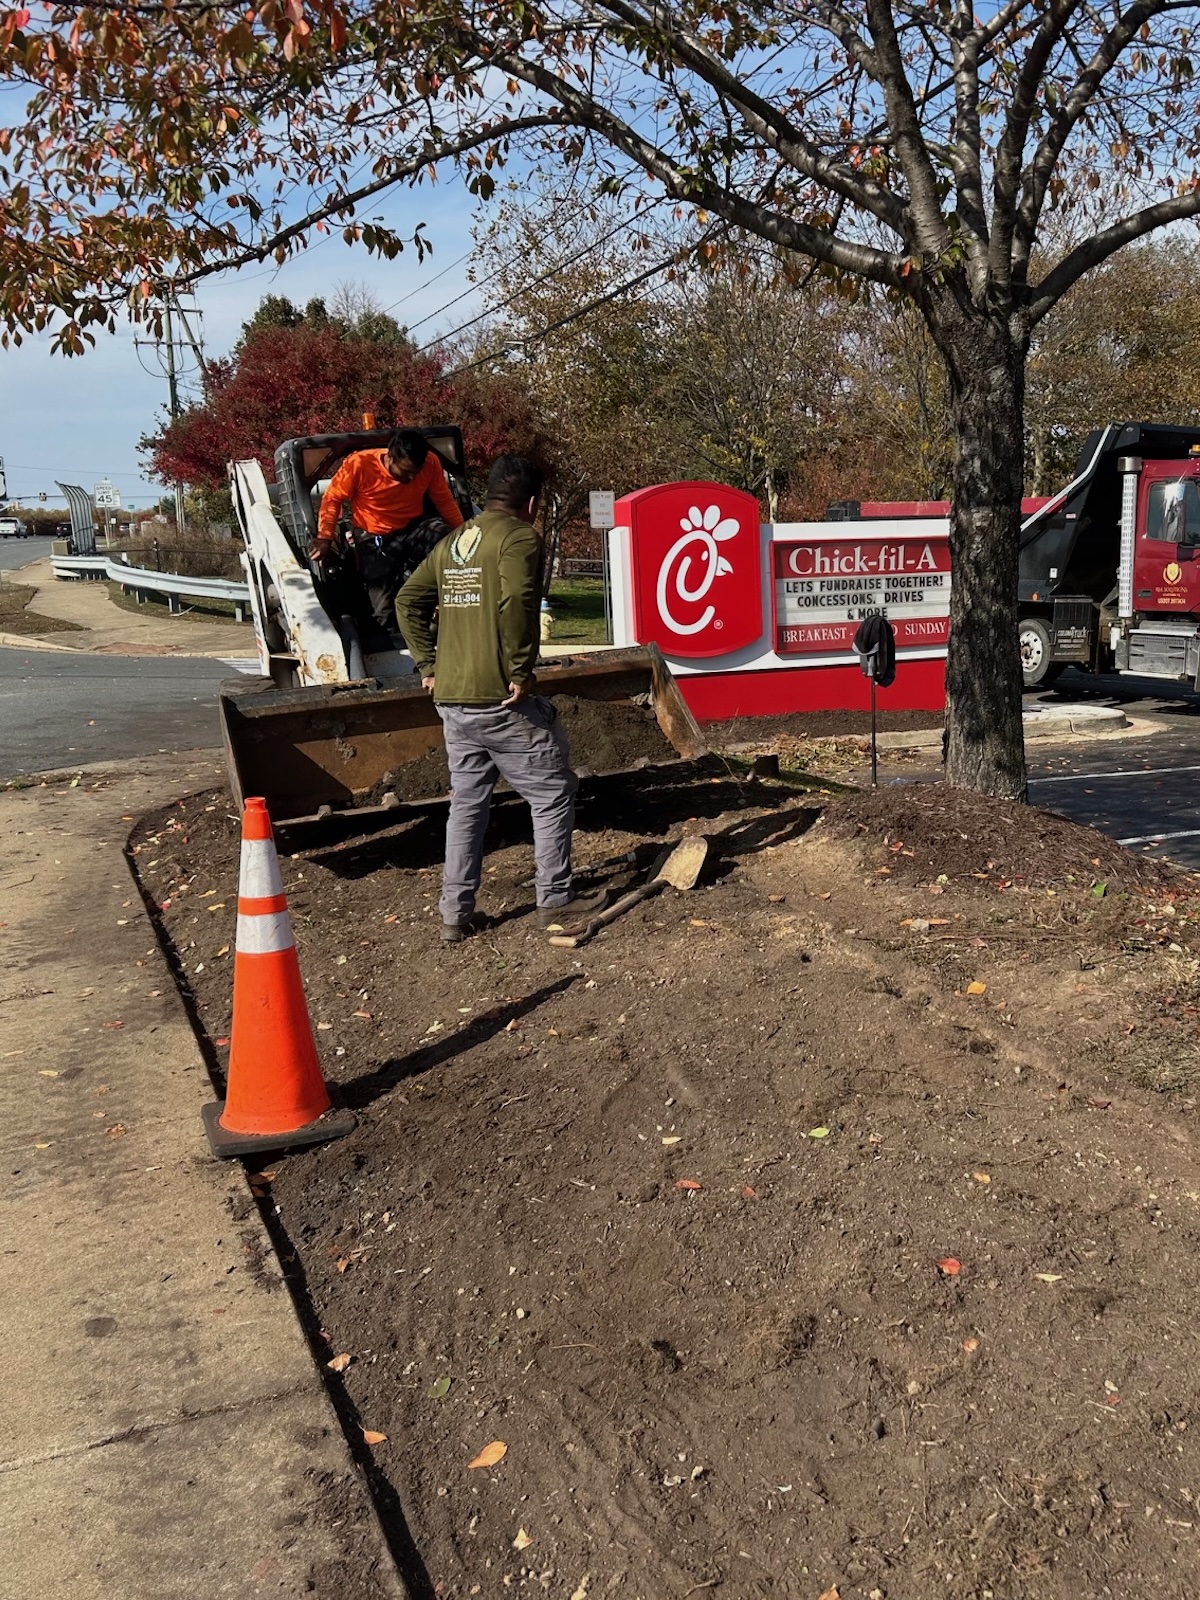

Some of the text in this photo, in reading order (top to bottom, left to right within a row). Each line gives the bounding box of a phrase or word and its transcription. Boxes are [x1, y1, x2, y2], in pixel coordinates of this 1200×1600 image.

[97, 495, 113, 503] 45
[789, 544, 937, 574] Chick-fil-A
[786, 575, 944, 593] LETS FUNDRAISE TOGETHER!
[884, 590, 924, 603] DRIVES
[847, 606, 888, 620] & MORE
[783, 626, 847, 643] BREAKFAST
[905, 621, 947, 636] SUNDAY
